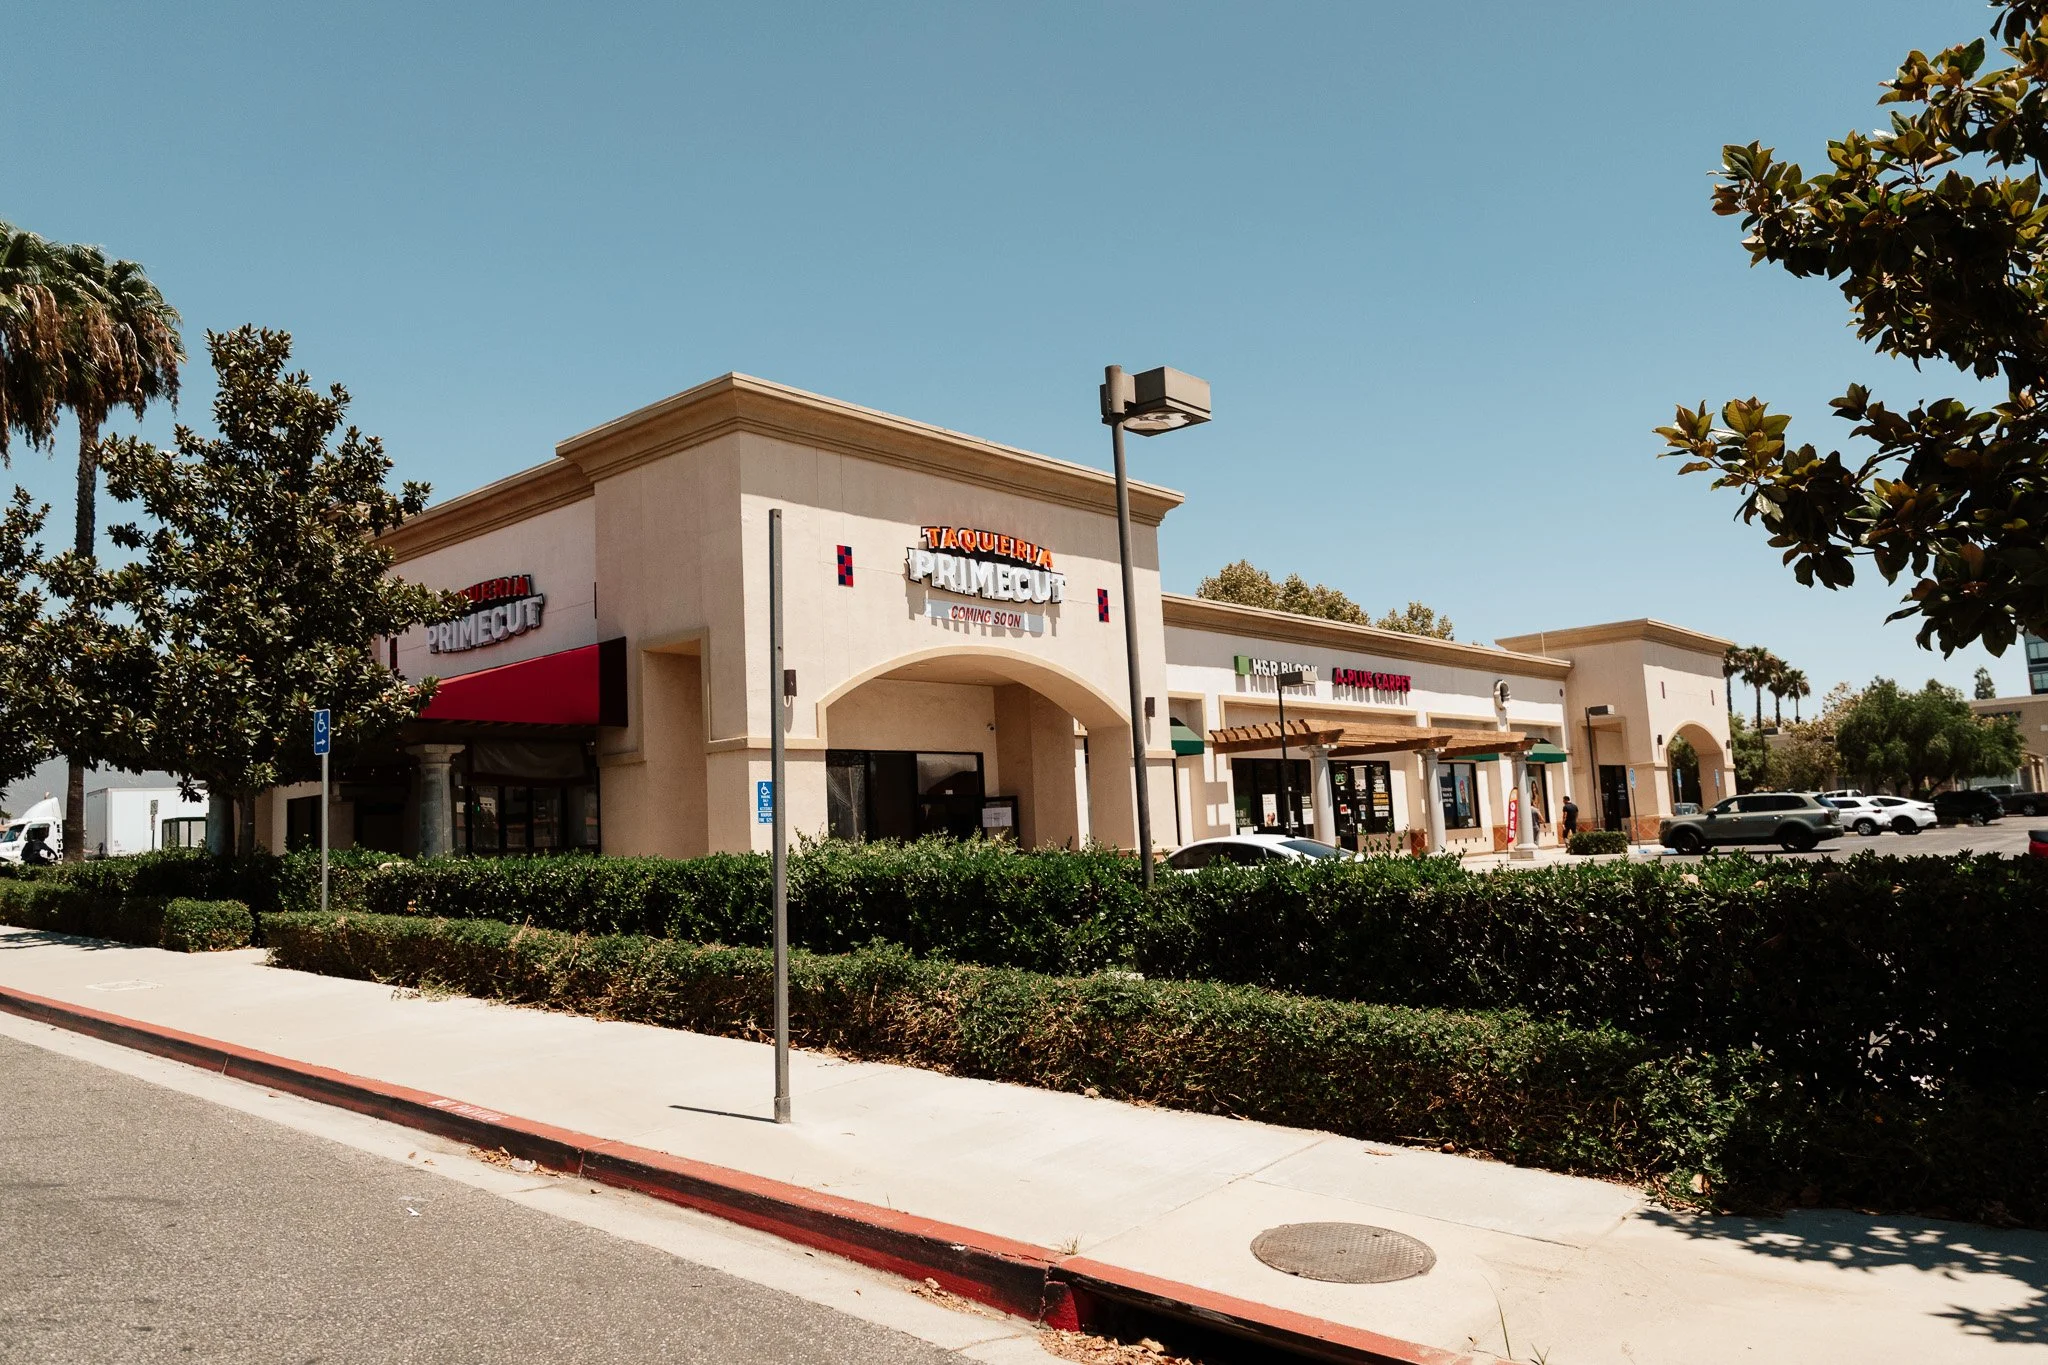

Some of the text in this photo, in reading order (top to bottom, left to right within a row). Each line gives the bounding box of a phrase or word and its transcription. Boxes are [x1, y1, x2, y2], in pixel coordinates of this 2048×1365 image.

[922, 527, 1054, 570] TAQUERIA
[454, 575, 532, 603] UERIA
[908, 549, 1066, 603] PRIMECUT
[427, 595, 544, 653] PRIMECUT
[951, 605, 1021, 628] COMING SOON
[1251, 658, 1279, 676] H&R
[1374, 672, 1412, 692] CARPET
